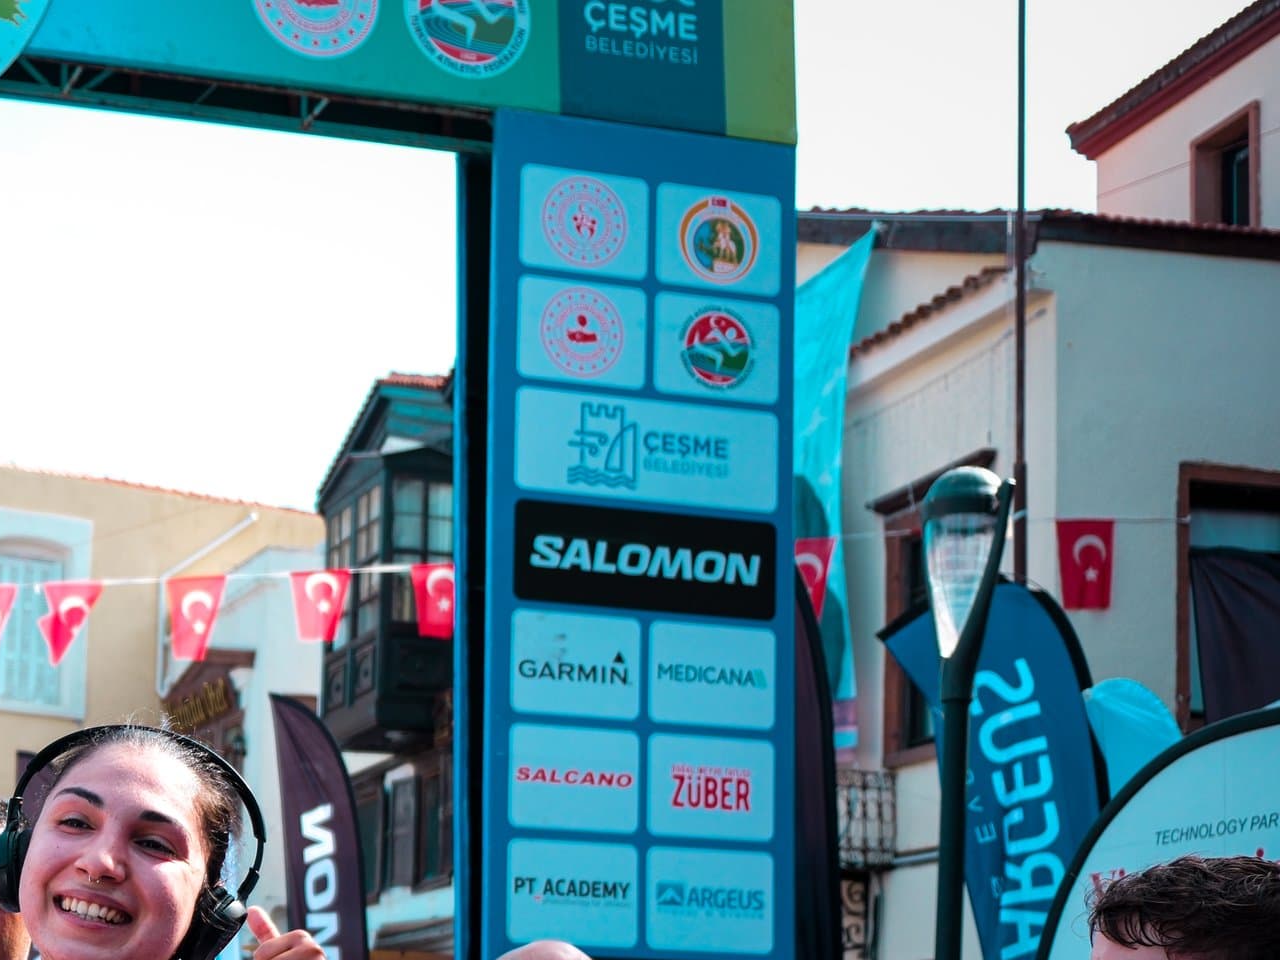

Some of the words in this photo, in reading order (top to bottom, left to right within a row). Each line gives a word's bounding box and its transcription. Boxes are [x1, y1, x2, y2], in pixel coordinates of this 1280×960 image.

[583, 1, 698, 41] ÇEŞME
[585, 35, 698, 65] BELEDİYESİ
[643, 430, 729, 460] ÇEŞME
[528, 534, 761, 587] SALOMON
[517, 658, 629, 686] GARMIN
[656, 663, 756, 688] MEDICANA
[516, 766, 633, 788] SALCANO
[671, 774, 751, 812] ZÜBER
[1155, 818, 1248, 846] TECHNOLOGY
[1250, 812, 1280, 832] PAR
[513, 876, 536, 895] PT
[542, 879, 631, 899] ACADEMY
[687, 886, 765, 912] ARGEUS
